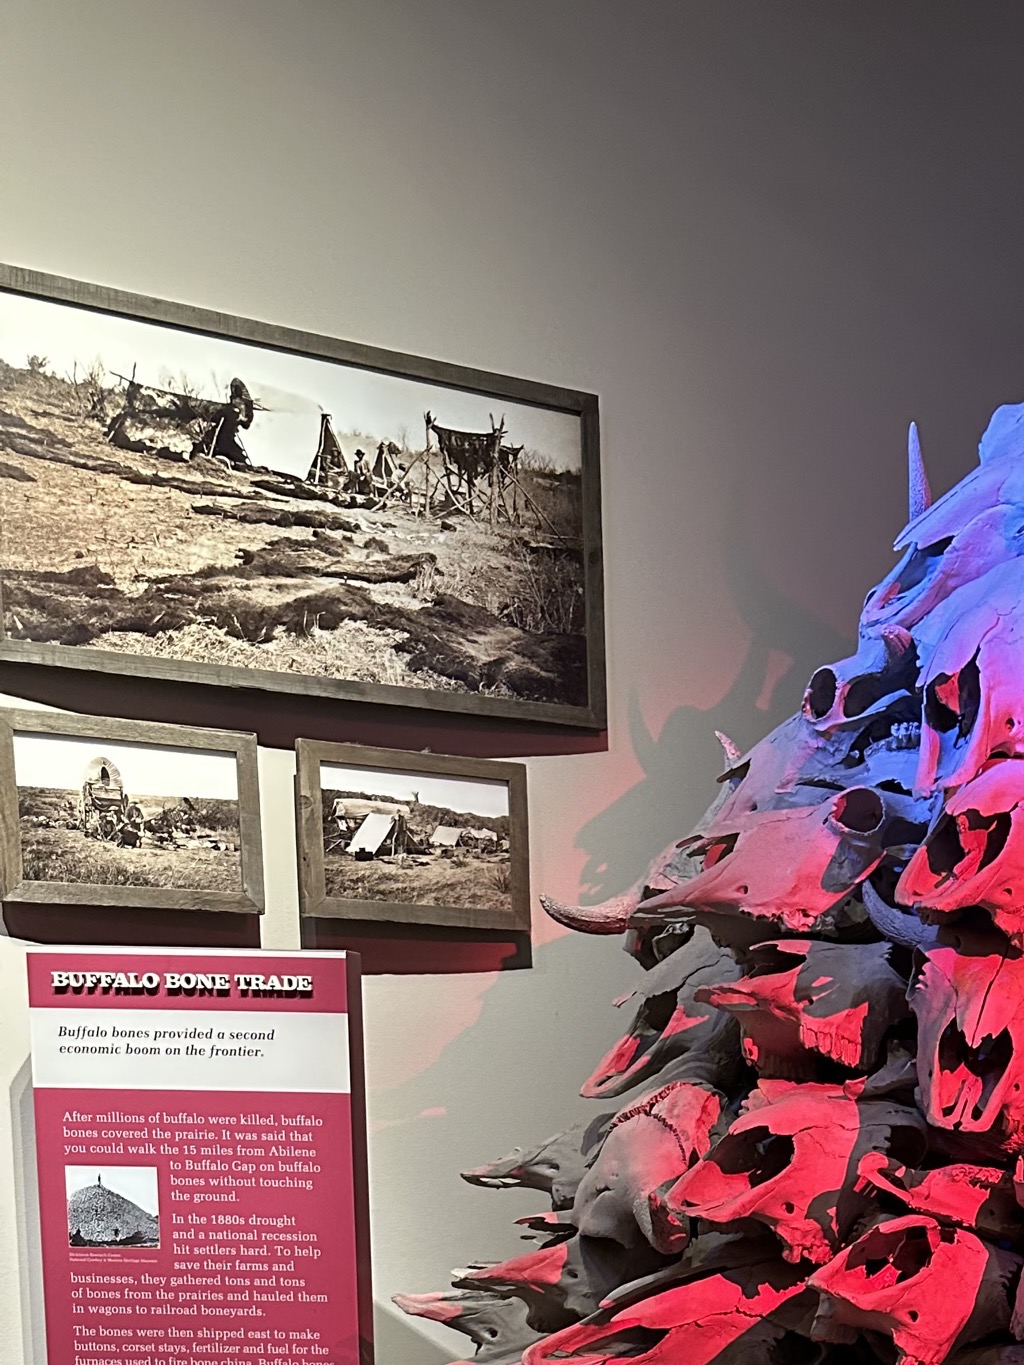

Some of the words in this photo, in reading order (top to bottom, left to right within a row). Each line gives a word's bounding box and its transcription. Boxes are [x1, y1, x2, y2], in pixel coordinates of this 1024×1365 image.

[50, 970, 160, 989] BUFFALO
[163, 972, 231, 990] BONE
[233, 973, 312, 991] TRADE
[57, 1025, 108, 1040] Buffalo
[111, 1026, 150, 1038] bones
[153, 1027, 213, 1041] provided
[216, 1031, 225, 1039] a
[229, 1028, 275, 1041] second
[59, 1044, 121, 1054] economic
[125, 1043, 161, 1055] boom
[164, 1047, 181, 1055] on
[185, 1044, 206, 1056] the
[208, 1044, 264, 1059] frontier.
[62, 1110, 93, 1122] After
[95, 1111, 145, 1123] millions
[147, 1111, 160, 1124] of
[162, 1111, 205, 1124] buffalo
[207, 1116, 237, 1125] were
[239, 1113, 278, 1126] killed,
[280, 1114, 323, 1126] buffalo
[62, 1126, 98, 1138] bones
[101, 1127, 148, 1139] covered
[151, 1127, 171, 1139] the
[174, 1128, 218, 1142] prairie.
[221, 1129, 231, 1140] It
[234, 1132, 258, 1141] was
[260, 1129, 286, 1141] said
[289, 1130, 313, 1142] that
[63, 1144, 87, 1155] you
[89, 1142, 124, 1154] could
[127, 1142, 157, 1154] walk
[159, 1142, 179, 1155] the
[182, 1144, 197, 1155] 15
[200, 1143, 233, 1156] miles
[236, 1144, 265, 1156] from
[268, 1145, 316, 1157] Abilene
[169, 1160, 182, 1170] to
[184, 1159, 229, 1171] Buffalo
[231, 1160, 256, 1174] Gap
[259, 1163, 275, 1172] on
[277, 1160, 321, 1173] buffalo
[169, 1173, 205, 1186] bones
[208, 1174, 256, 1187] without
[259, 1176, 313, 1190] touching
[170, 1189, 190, 1201] the
[193, 1190, 240, 1204] ground.
[172, 1212, 184, 1224] In
[187, 1212, 207, 1224] the
[210, 1214, 245, 1225] 1880s
[248, 1213, 296, 1228] drought
[172, 1228, 195, 1239] and
[198, 1231, 205, 1239] a
[208, 1228, 258, 1240] national
[261, 1230, 317, 1242] recession
[172, 1243, 190, 1255] hit
[193, 1243, 237, 1255] settlers
[239, 1244, 271, 1256] hard.
[273, 1245, 291, 1256] To
[294, 1245, 321, 1259] help
[173, 1261, 200, 1270] save
[203, 1258, 232, 1271] their
[235, 1259, 269, 1271] farms
[271, 1260, 295, 1271] and
[70, 1272, 138, 1285] businesses,
[140, 1273, 167, 1287] they
[170, 1274, 221, 1287] gathered
[224, 1275, 251, 1286] tons
[253, 1275, 276, 1286] and
[279, 1276, 306, 1287] tons
[70, 1287, 83, 1298] of
[85, 1287, 121, 1299] bones
[124, 1288, 152, 1299] from
[155, 1288, 175, 1300] the
[178, 1289, 224, 1302] prairies
[226, 1289, 250, 1301] and
[252, 1290, 294, 1302] hauled
[297, 1290, 328, 1302] them
[72, 1302, 84, 1313] in
[87, 1305, 132, 1316] wagons
[135, 1304, 147, 1314] to
[150, 1303, 197, 1315] railroad
[200, 1304, 266, 1318] boneyards.
[72, 1325, 96, 1336] The
[98, 1325, 133, 1337] bones
[136, 1329, 165, 1337] were
[167, 1326, 194, 1338] then
[197, 1326, 245, 1341] shipped
[247, 1329, 271, 1339] east
[273, 1329, 286, 1339] to
[288, 1328, 320, 1340] make
[73, 1339, 120, 1352] buttons,
[121, 1342, 156, 1352] corset
[158, 1342, 190, 1355] stays,
[192, 1341, 241, 1354] fertilizer
[242, 1342, 265, 1354] and
[267, 1342, 289, 1354] fuel
[291, 1343, 309, 1355] for
[310, 1343, 329, 1355] the
